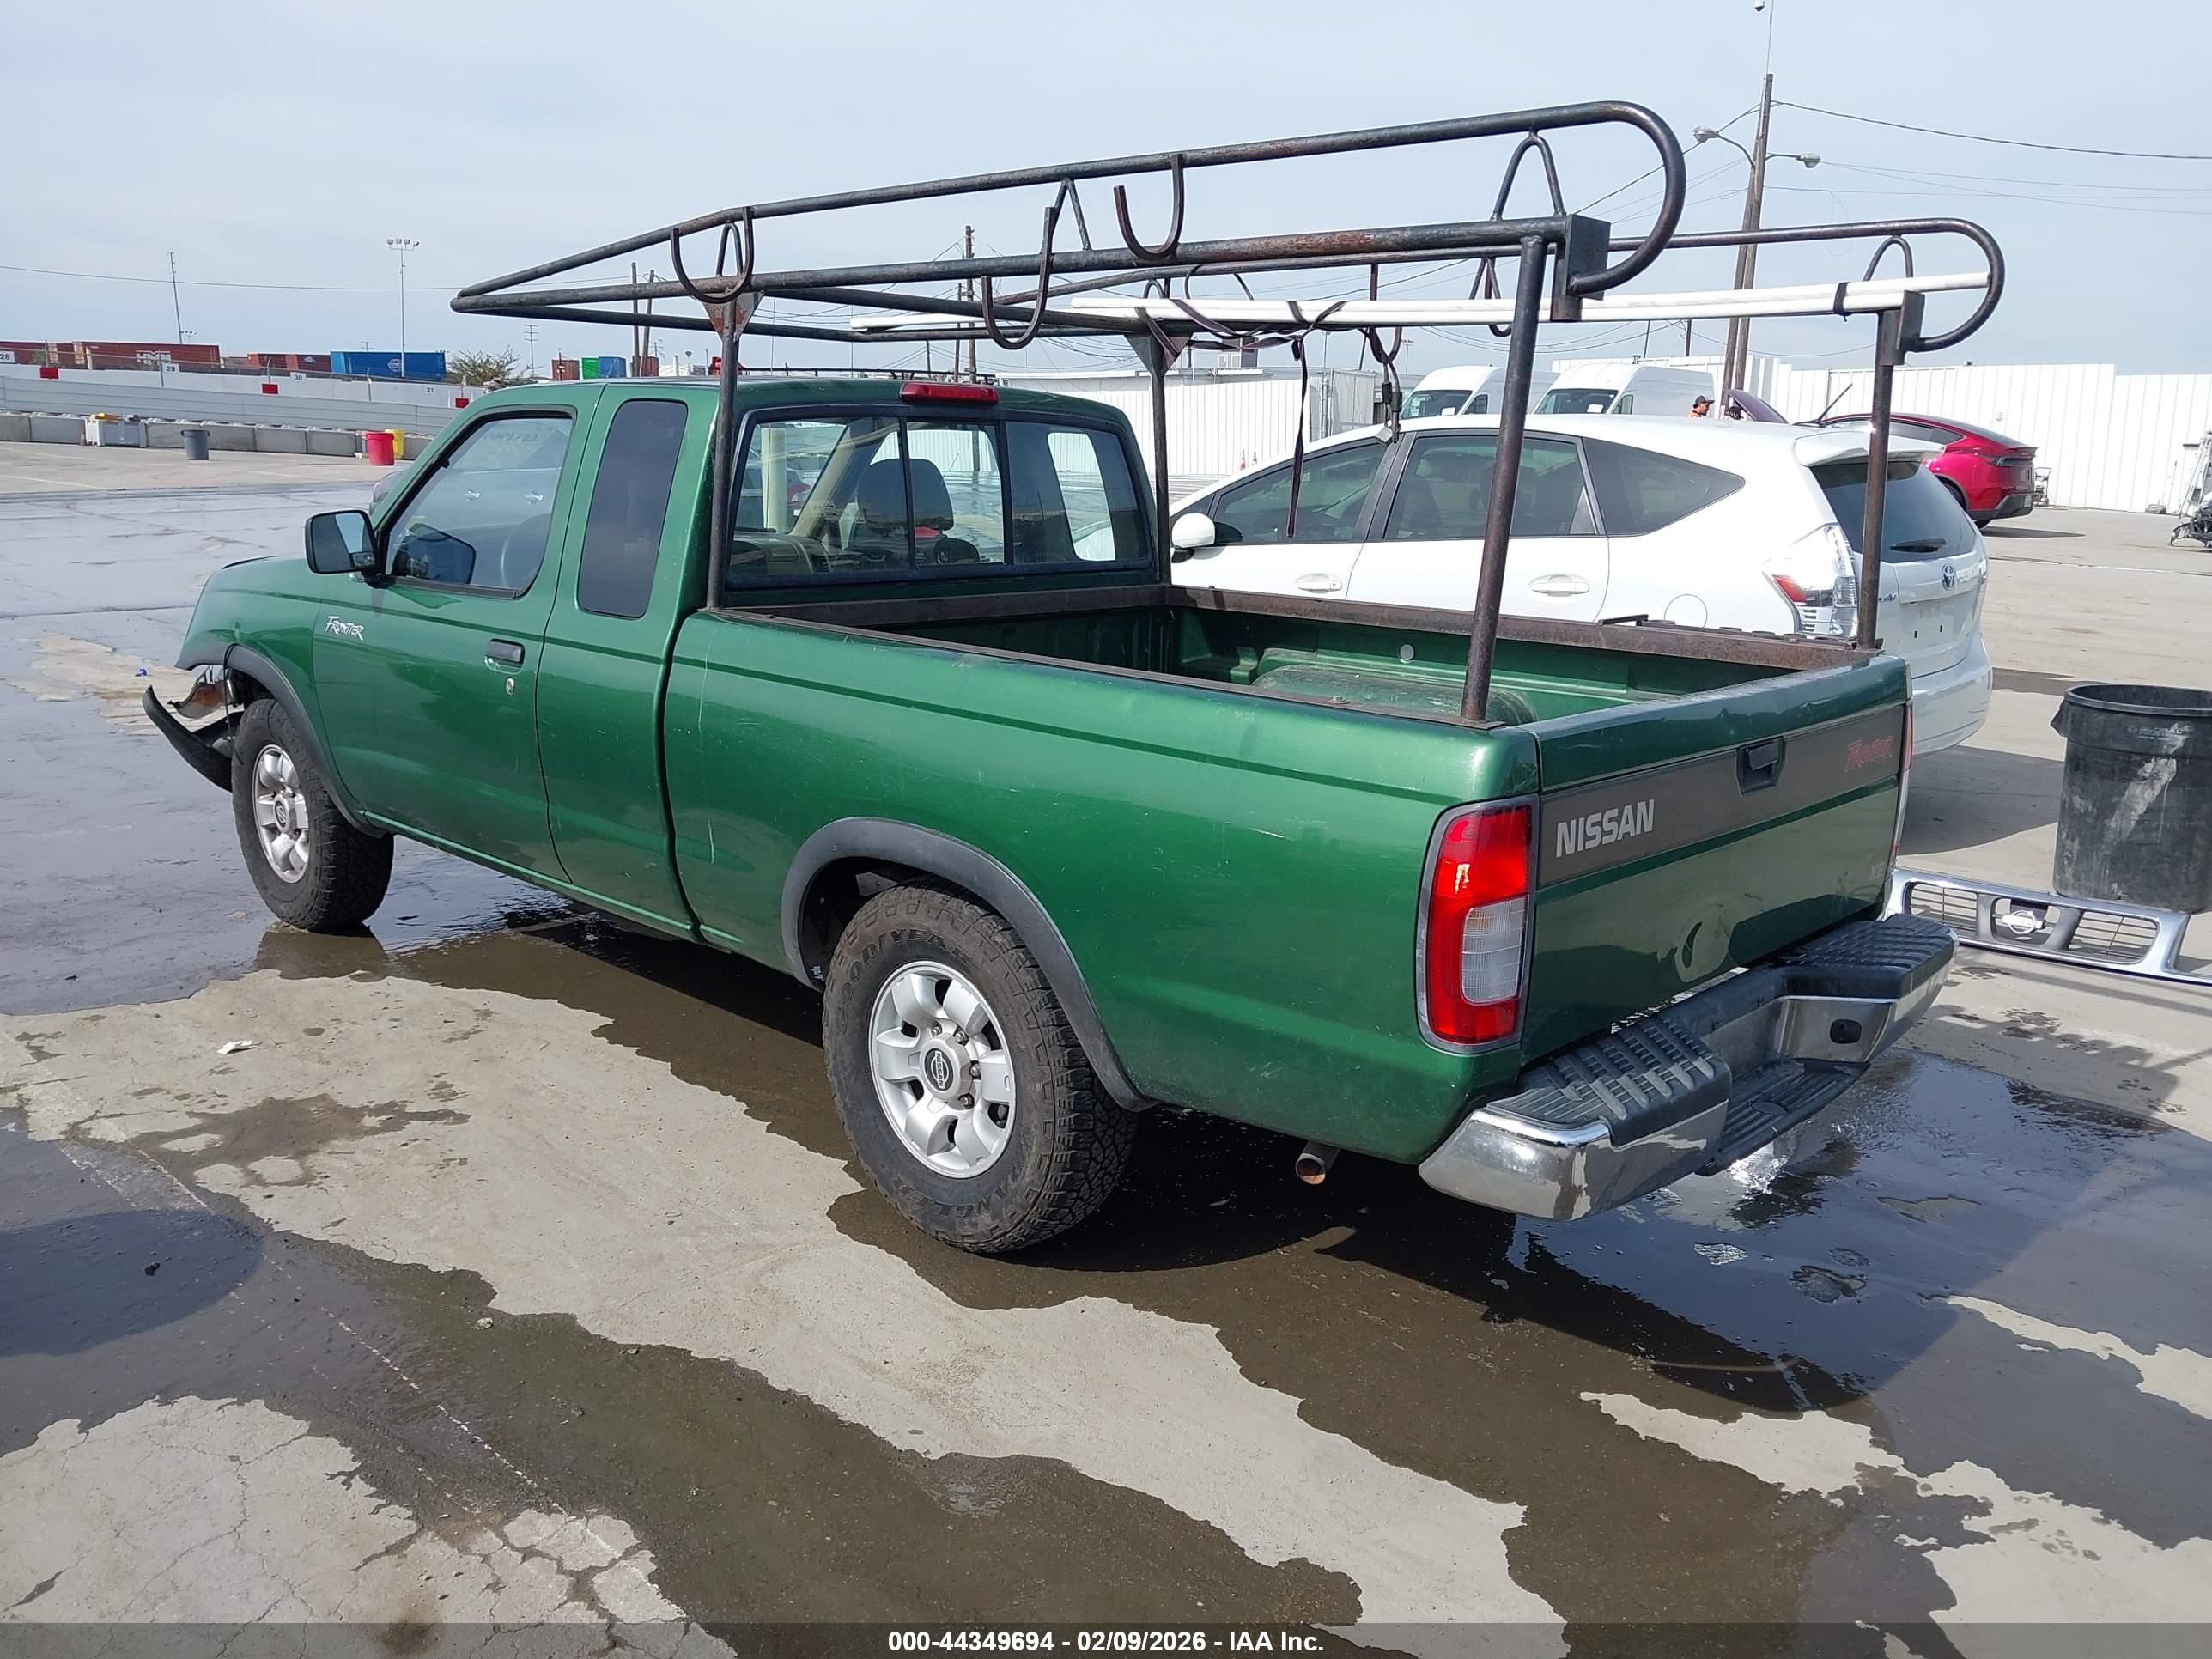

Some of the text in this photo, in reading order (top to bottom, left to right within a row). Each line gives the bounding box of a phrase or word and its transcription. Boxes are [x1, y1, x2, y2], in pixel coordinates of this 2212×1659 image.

[1555, 799, 1656, 858] NISSAN
[836, 927, 970, 1033] GOODYEAR
[934, 1050, 945, 1090] NISSAN
